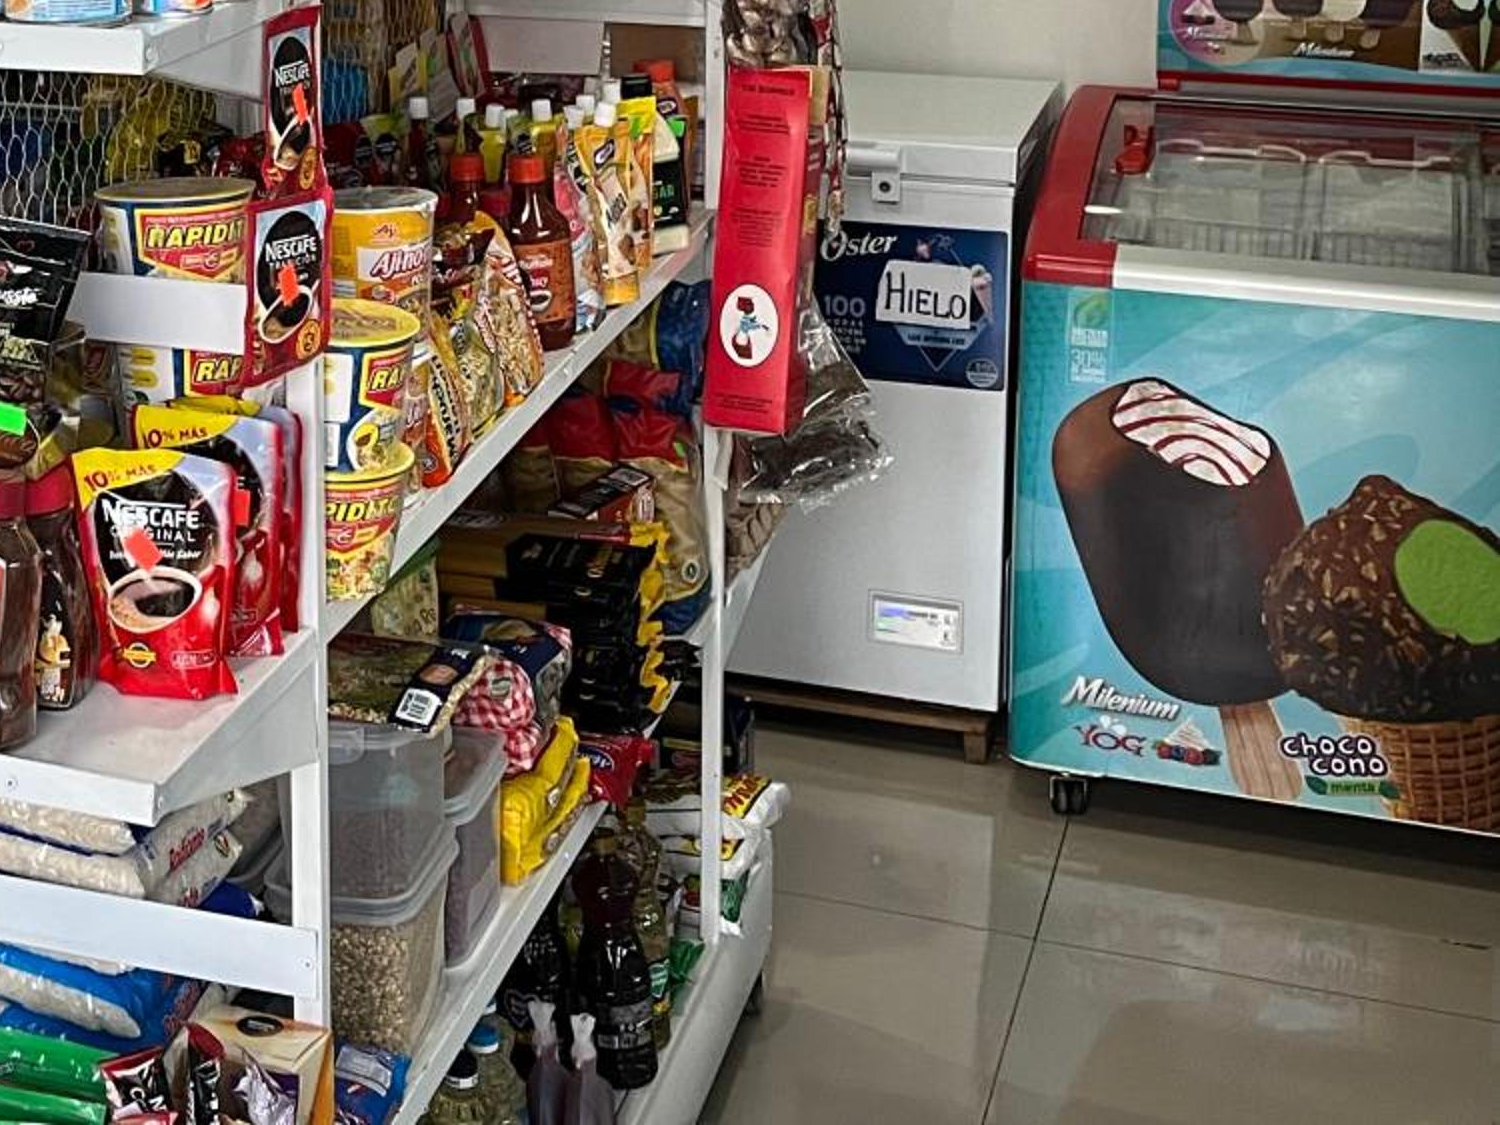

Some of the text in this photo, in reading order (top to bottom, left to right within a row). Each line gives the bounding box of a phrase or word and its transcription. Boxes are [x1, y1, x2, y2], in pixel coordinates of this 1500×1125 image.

[820, 228, 898, 262] Oster
[823, 295, 867, 318] 100
[883, 270, 968, 320] HIELO
[1061, 674, 1182, 721] Milenium
[1279, 733, 1377, 759] choco
[1309, 753, 1390, 777] cono
